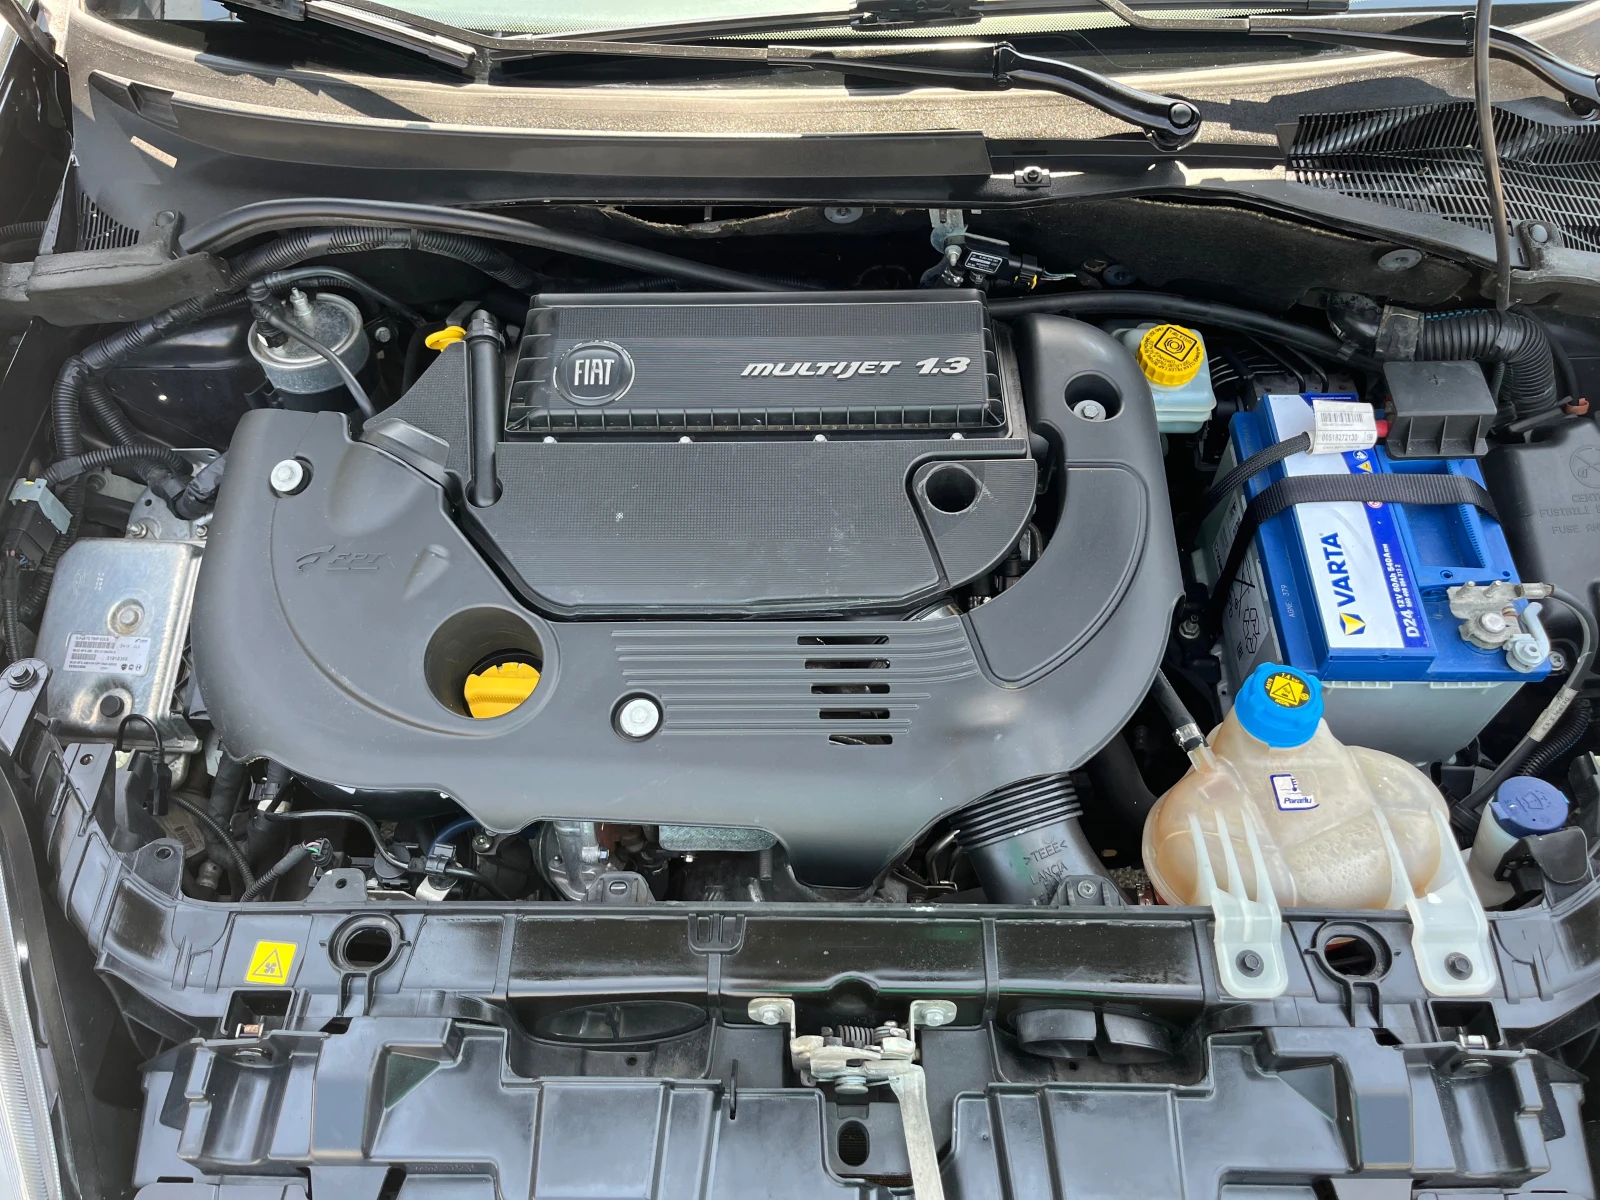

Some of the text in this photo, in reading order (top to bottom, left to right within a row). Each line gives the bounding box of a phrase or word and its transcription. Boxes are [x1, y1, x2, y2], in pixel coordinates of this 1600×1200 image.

[574, 359, 615, 386] FIAT
[740, 356, 971, 381] MULTIJET 1.3
[1551, 524, 1580, 535] FUSE
[1320, 532, 1356, 608] VARTA
[1281, 584, 1290, 597] 379
[1389, 573, 1400, 592] 60Ah
[1393, 592, 1405, 607] 12V
[1400, 609, 1420, 638] D24
[1030, 861, 1069, 885] LANCIA
